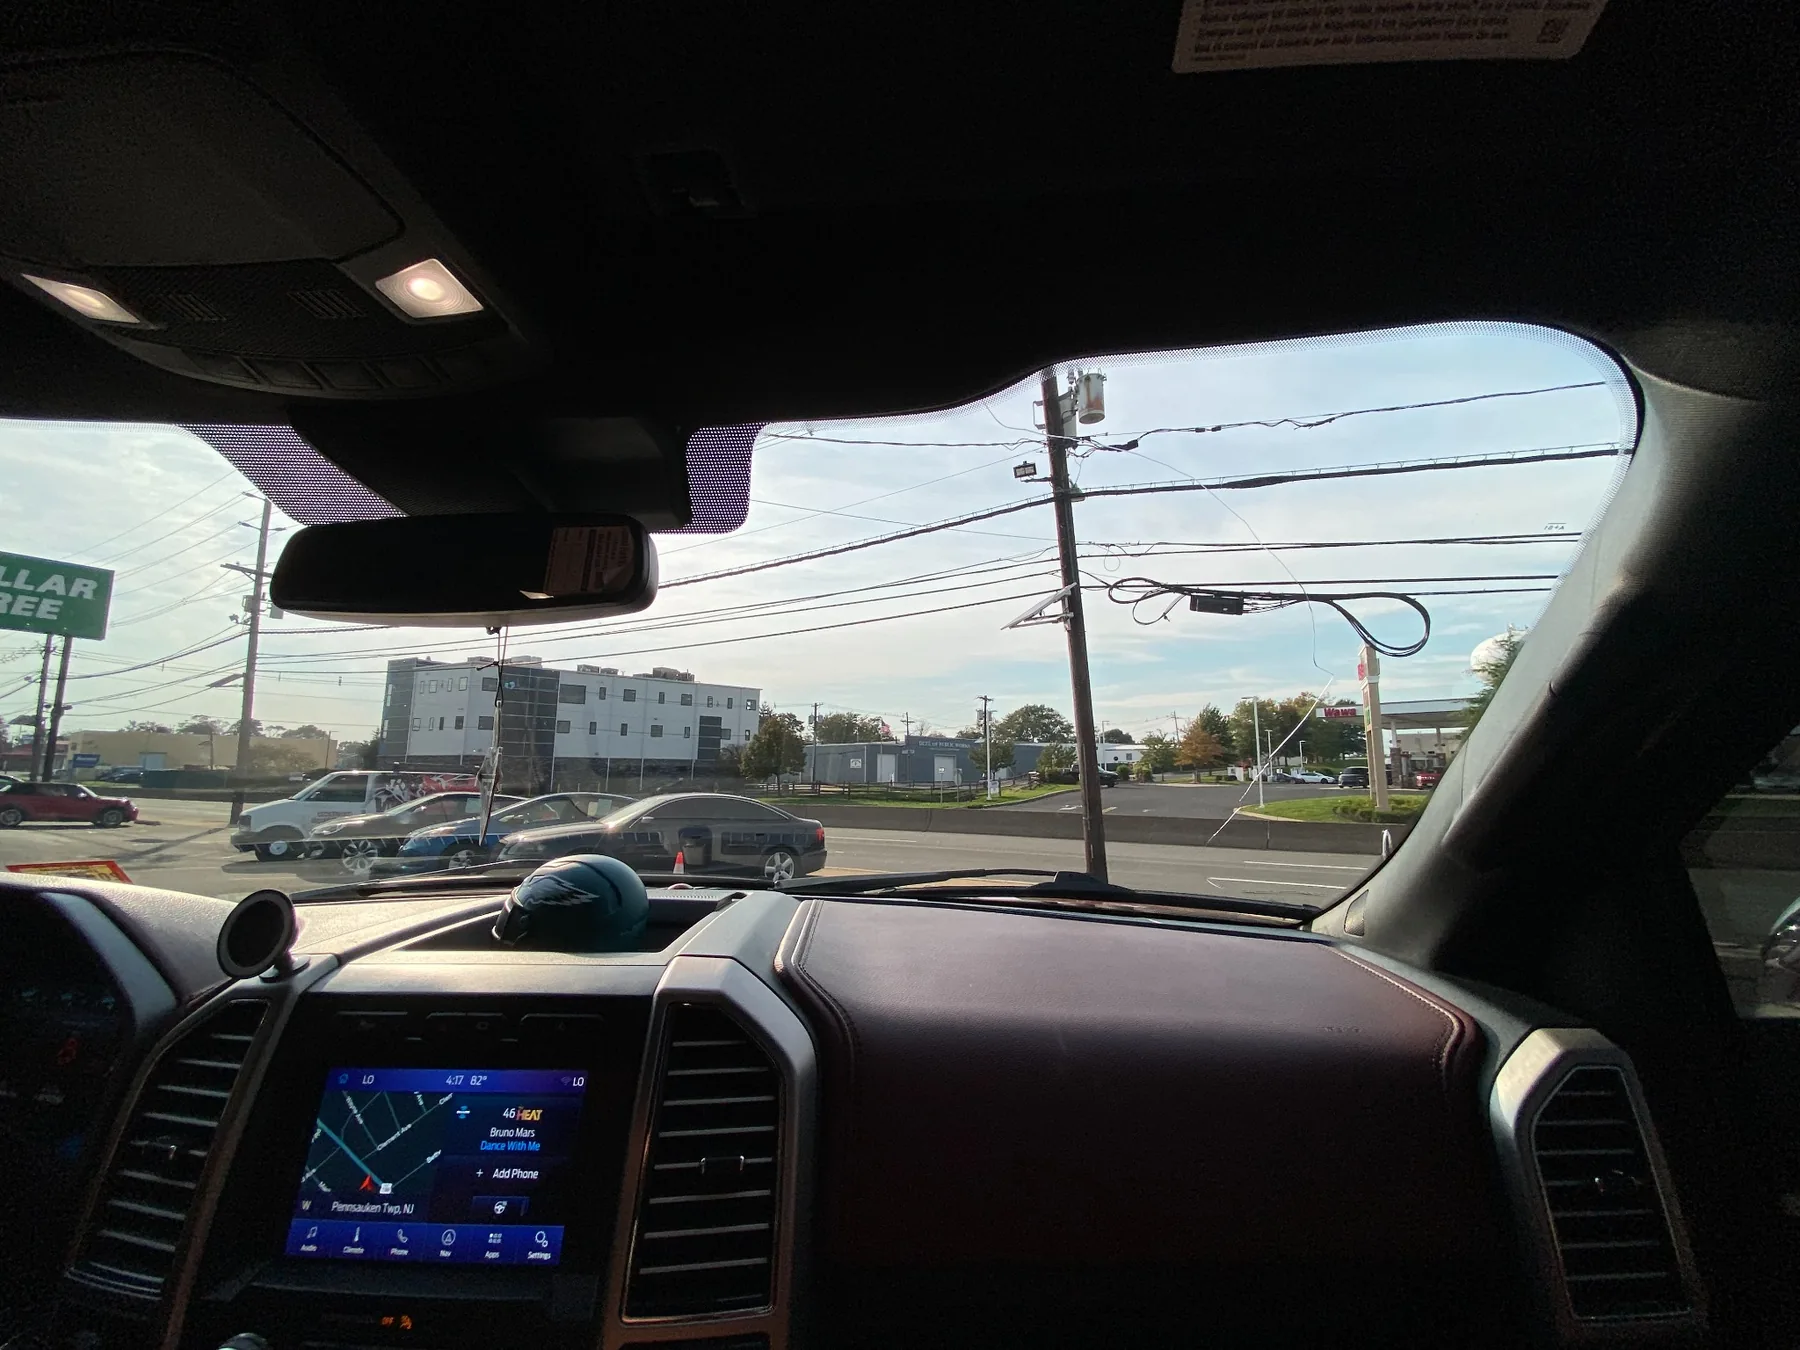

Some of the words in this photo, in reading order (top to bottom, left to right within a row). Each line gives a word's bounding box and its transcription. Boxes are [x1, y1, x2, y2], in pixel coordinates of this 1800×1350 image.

[1324, 707, 1357, 718] Wawa
[362, 1075, 375, 1085] LO
[445, 1075, 465, 1085] 4:17
[470, 1075, 488, 1086] 82°
[572, 1076, 585, 1087] LO
[502, 1107, 516, 1119] 46
[516, 1109, 543, 1121] HEAT
[490, 1127, 514, 1138] Bruno
[515, 1127, 536, 1138] Mars
[480, 1140, 506, 1151] Dance
[507, 1140, 527, 1151] With
[528, 1140, 541, 1151] Me
[492, 1168, 511, 1179] Add
[511, 1168, 539, 1179] Phone
[302, 1200, 312, 1210] W
[331, 1201, 382, 1213] Pennsauken
[382, 1202, 402, 1215] Twp,
[403, 1203, 415, 1214] NJ
[390, 1248, 409, 1256] Phone
[484, 1251, 500, 1259] Apps
[527, 1251, 552, 1260] Settings
